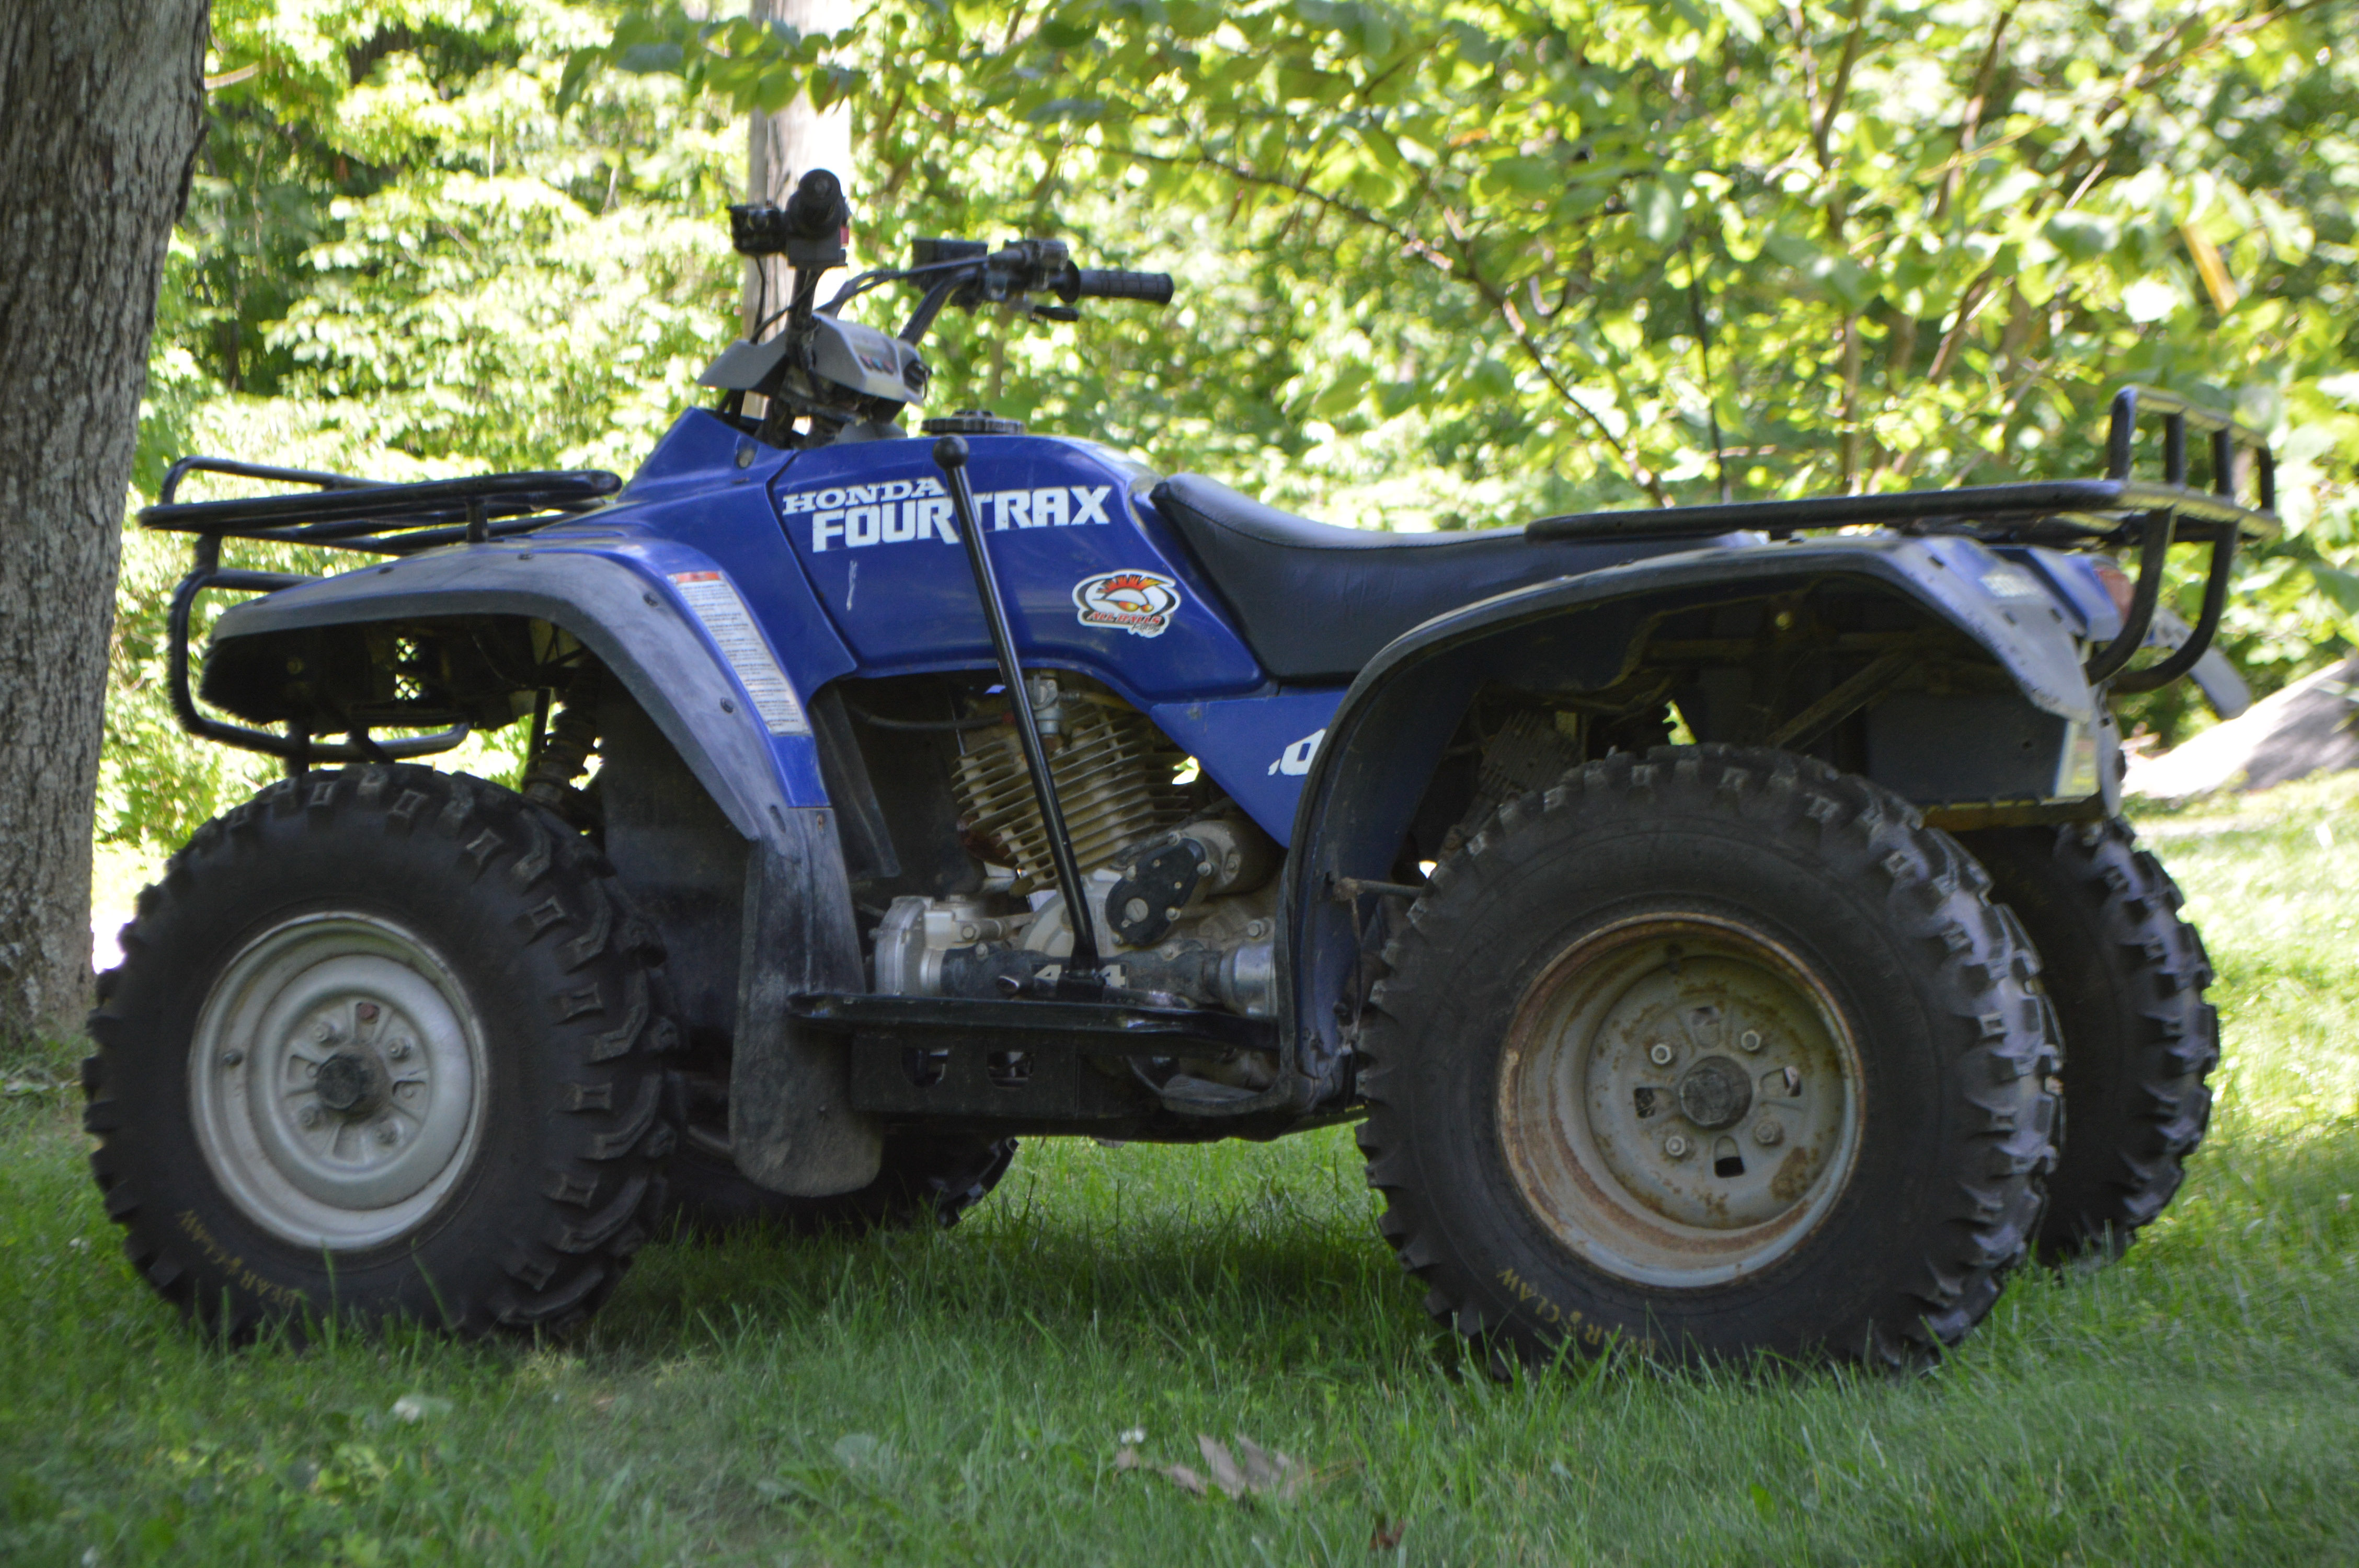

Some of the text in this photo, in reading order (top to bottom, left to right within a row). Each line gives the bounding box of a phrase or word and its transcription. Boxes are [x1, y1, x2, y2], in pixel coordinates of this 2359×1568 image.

[782, 476, 947, 515] HONDA
[1086, 611, 1162, 626] ALL BALLS
[1497, 1268, 1560, 1323] CLAW
